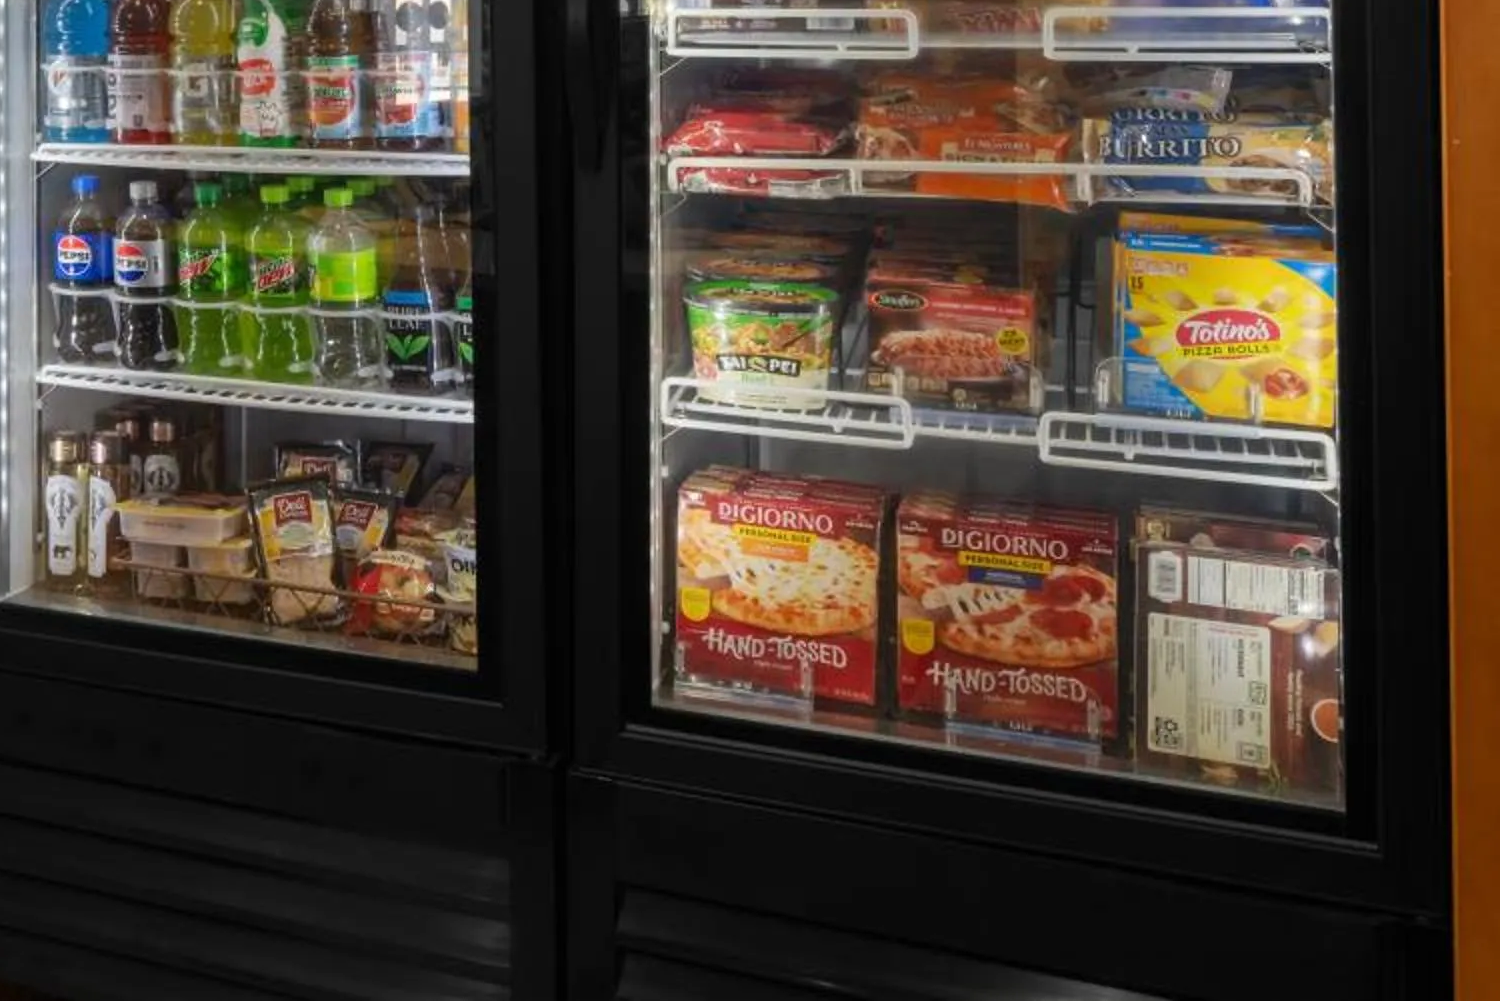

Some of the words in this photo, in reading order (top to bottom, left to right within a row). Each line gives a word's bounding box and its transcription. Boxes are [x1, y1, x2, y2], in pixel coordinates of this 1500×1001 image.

[1099, 135, 1241, 160] BURRITO
[59, 250, 89, 262] PEPSI
[117, 258, 147, 270] PEPSI
[1184, 317, 1271, 344] Totino's
[1183, 346, 1222, 358] PIZZA
[1226, 344, 1271, 357] ROLLS
[720, 355, 746, 371] TAI
[770, 358, 798, 375] PEI
[739, 527, 789, 542] PERSONAL
[791, 534, 812, 545] SIZE
[964, 554, 1020, 568] PERSONAL
[1021, 561, 1046, 572] SIZE
[702, 627, 848, 670] HAND-TOSSED
[925, 660, 1088, 703] HAND-TOSSED
